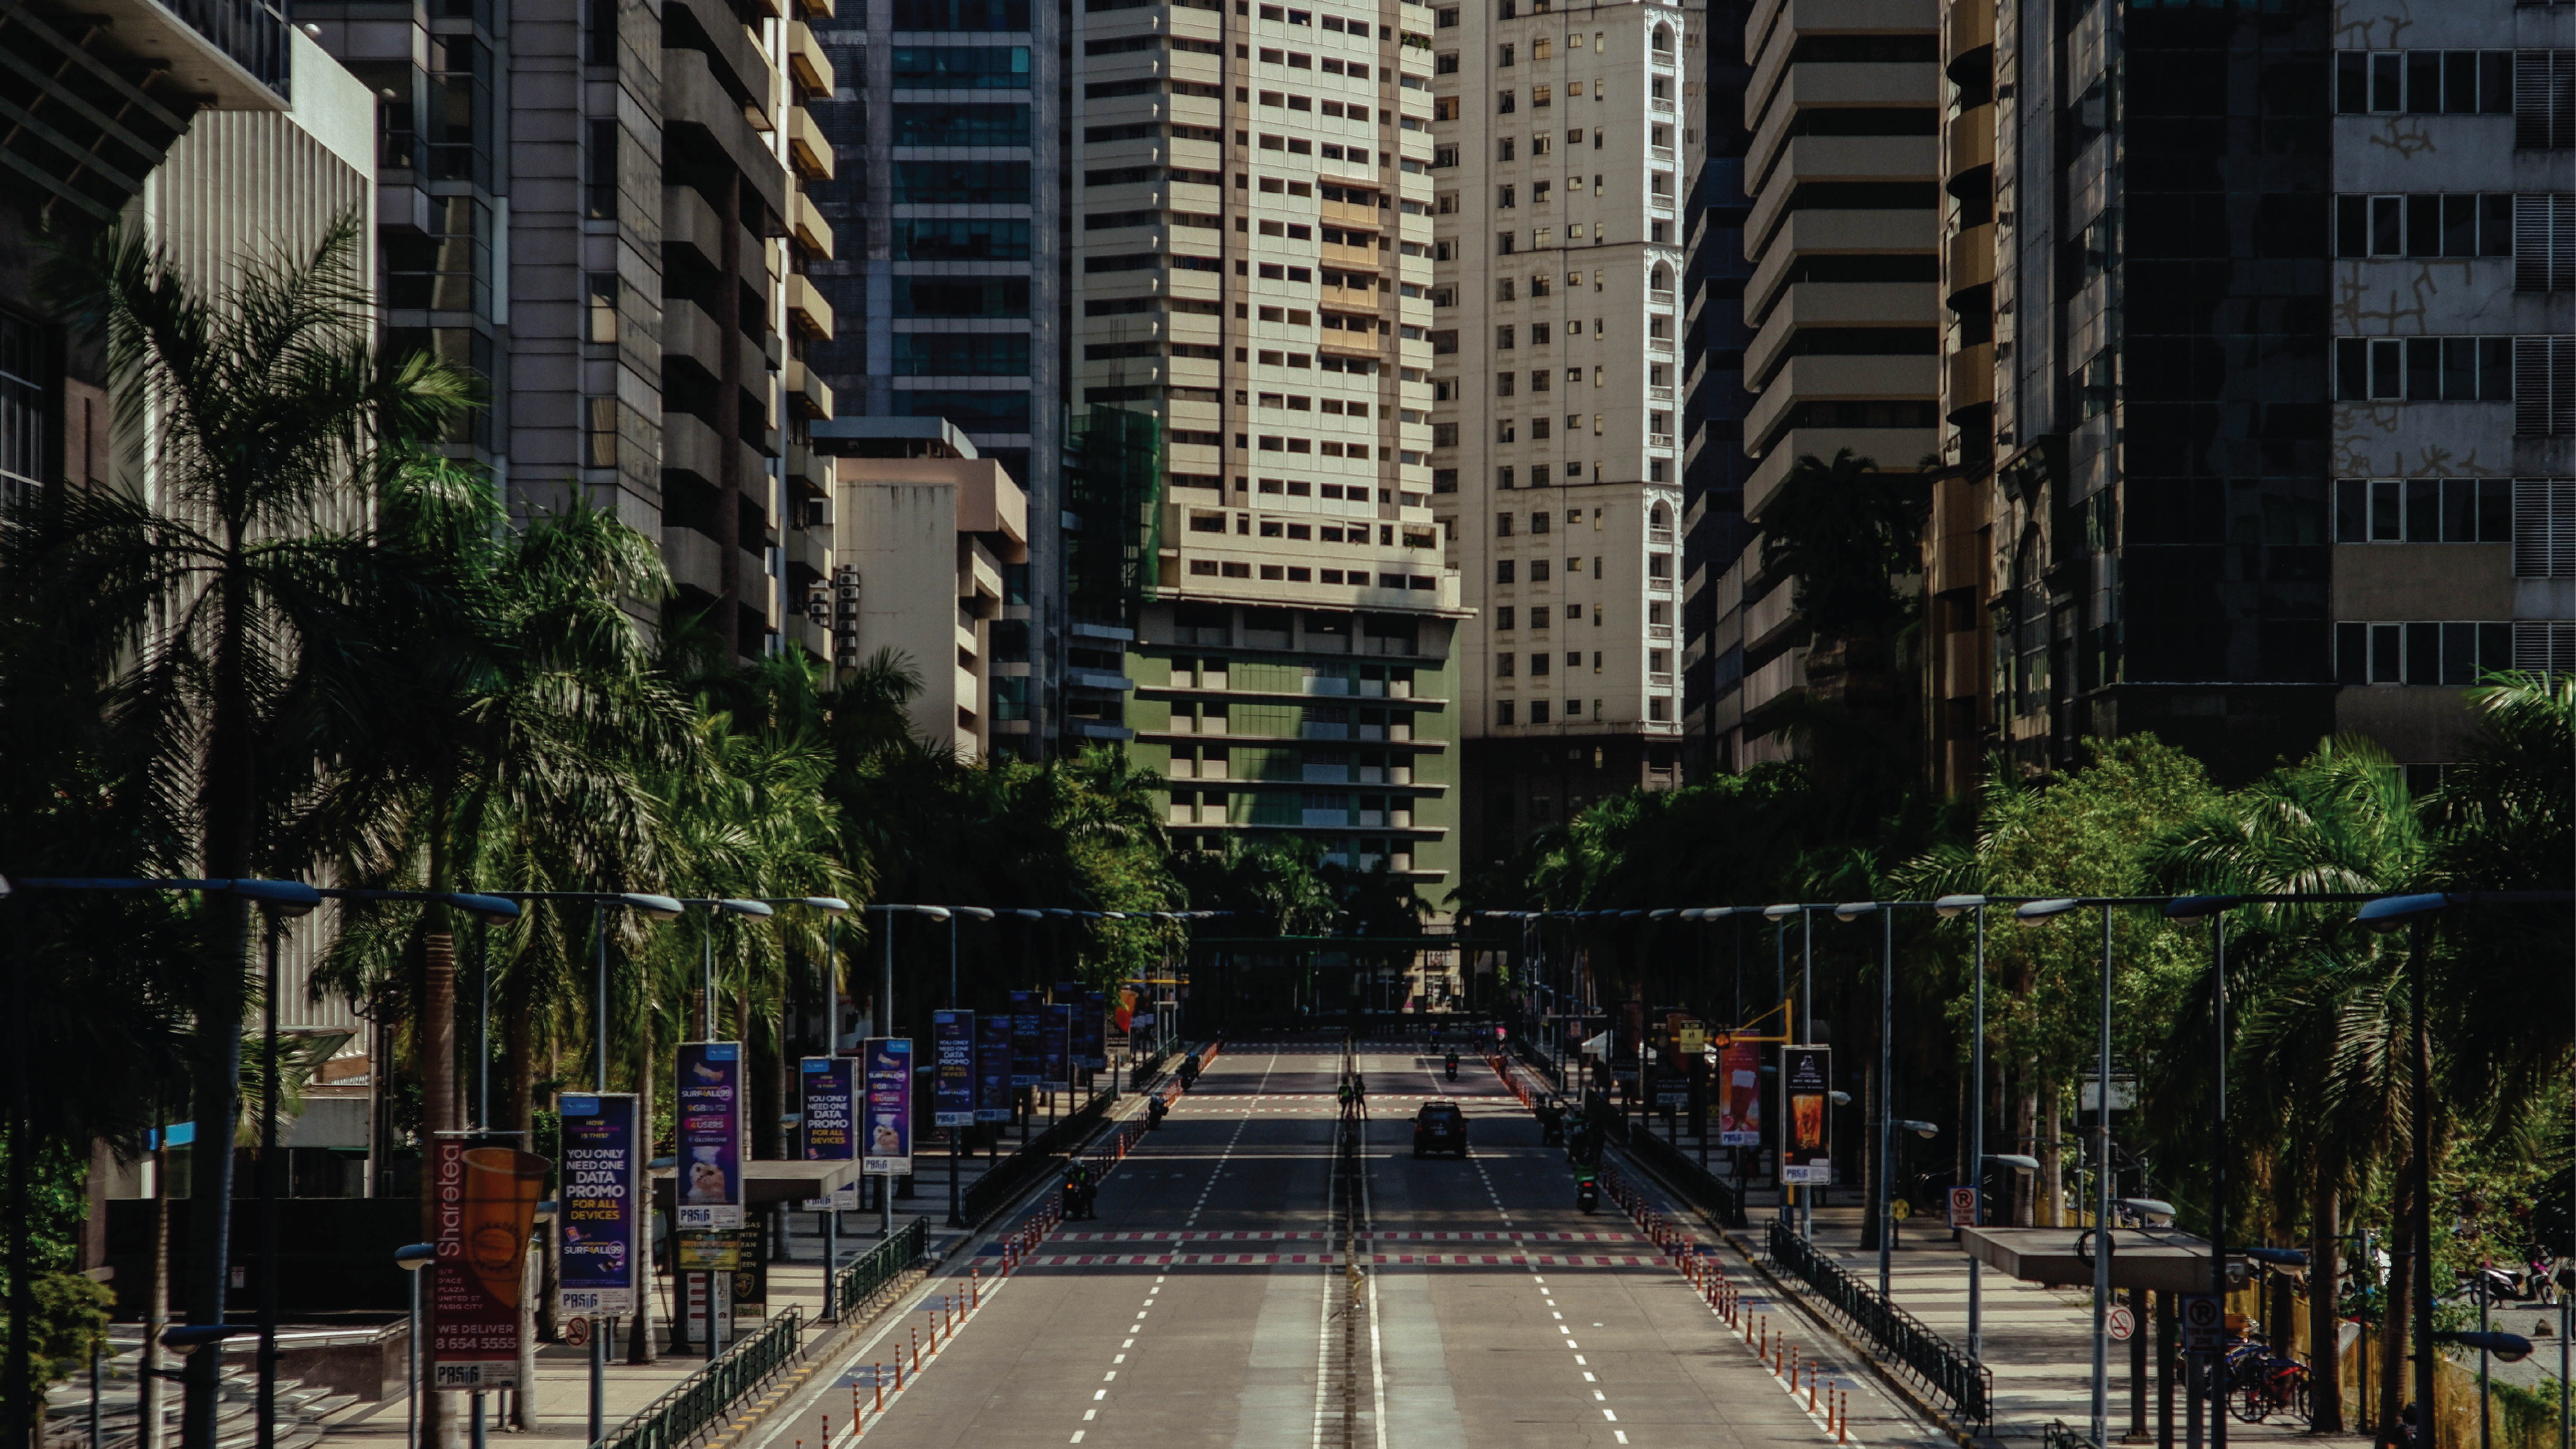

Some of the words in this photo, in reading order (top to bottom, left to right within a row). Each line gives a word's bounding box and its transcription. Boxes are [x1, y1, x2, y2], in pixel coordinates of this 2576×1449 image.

[814, 1110, 842, 1119] DATA
[807, 1119, 849, 1128] PROMO
[566, 1149, 593, 1159] YOU
[594, 1149, 625, 1159] ONLY
[566, 1160, 597, 1170] NEED
[599, 1160, 625, 1170] ONE
[575, 1171, 617, 1184] DATA
[566, 1185, 626, 1198] PROMO
[437, 1145, 459, 1256] Sharetea
[572, 1199, 595, 1208] FOR
[597, 1199, 619, 1208] ALL
[570, 1211, 621, 1220] DEVICES
[437, 1324, 458, 1334] WE
[461, 1324, 514, 1334] DELIVER
[435, 1337, 445, 1350] 8
[448, 1337, 477, 1350] 654
[481, 1337, 517, 1350] 5555
